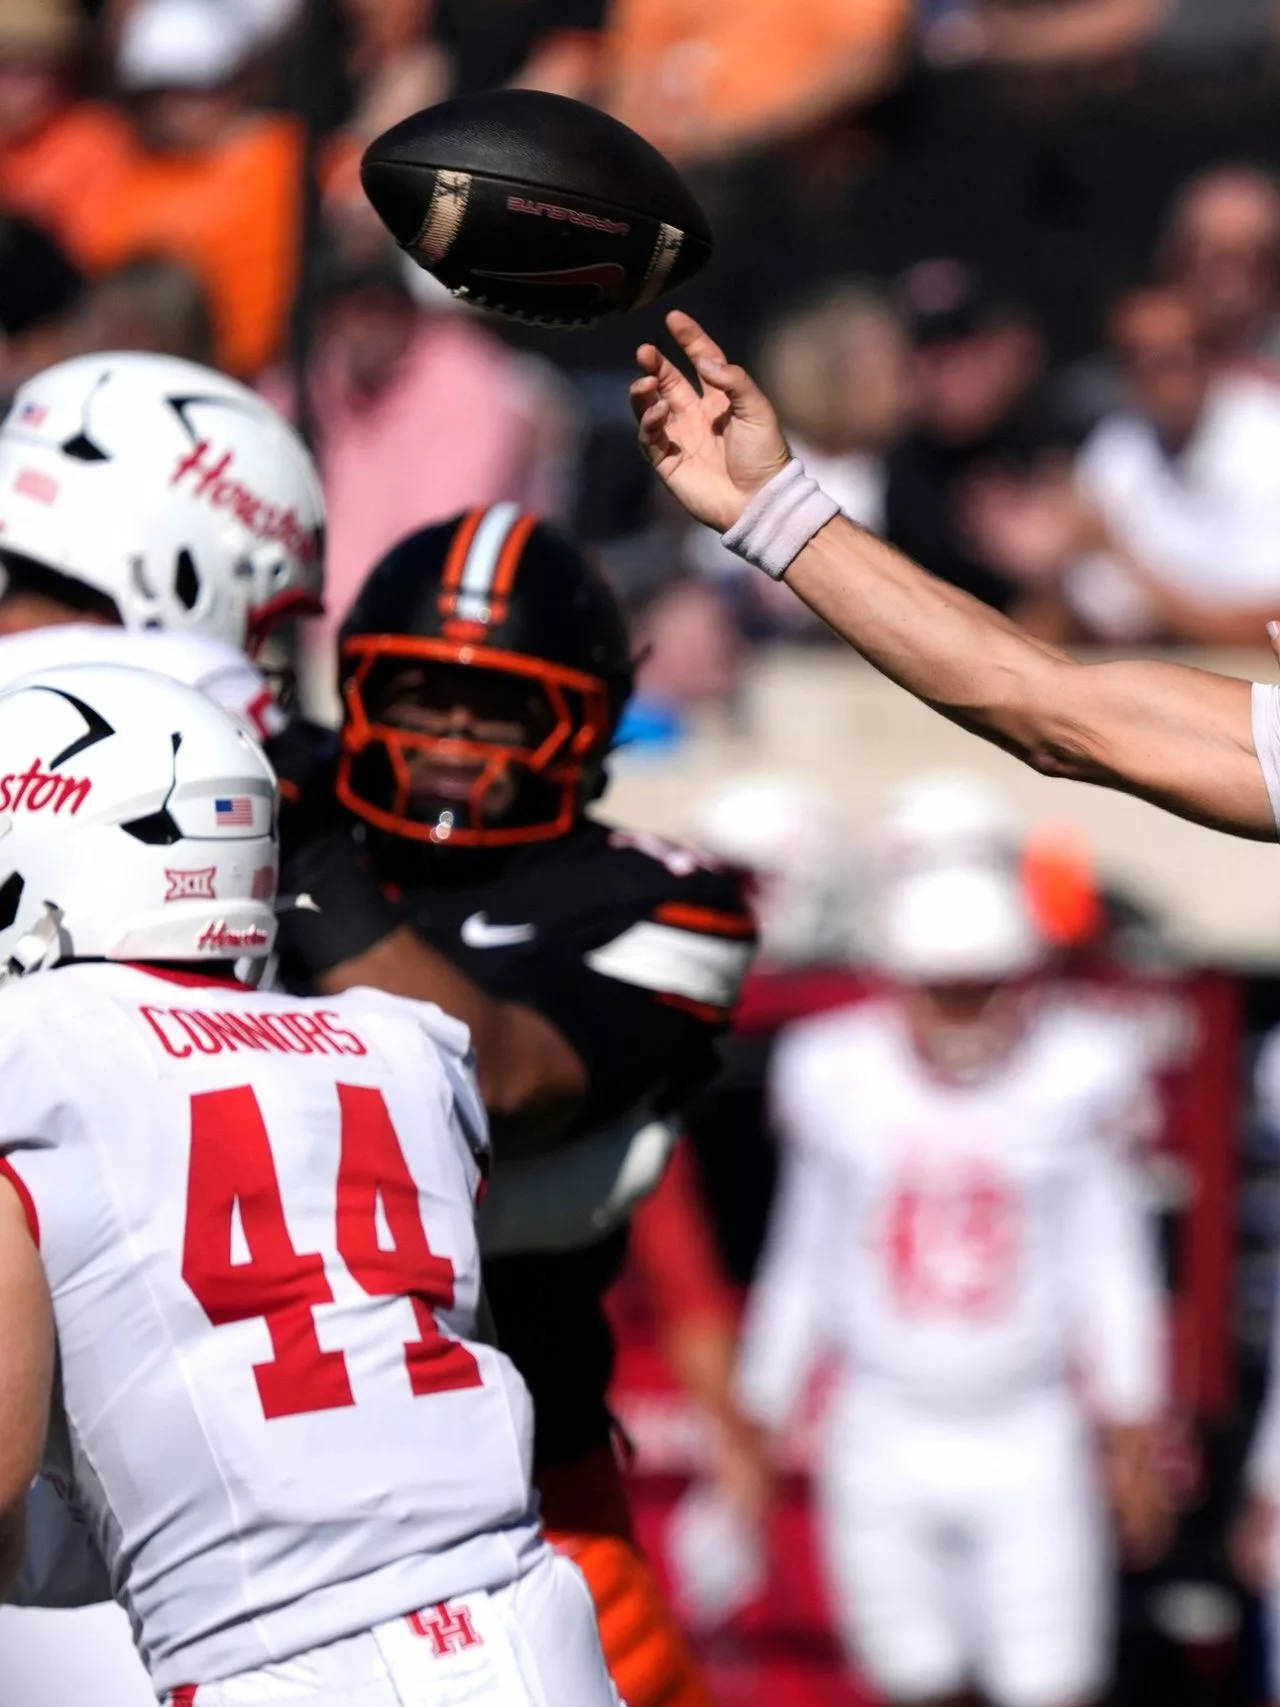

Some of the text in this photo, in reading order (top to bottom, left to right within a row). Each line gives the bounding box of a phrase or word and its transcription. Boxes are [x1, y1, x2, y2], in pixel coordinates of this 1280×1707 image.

[0, 757, 92, 816] ston
[138, 1004, 368, 1059] CONNORS
[181, 1079, 485, 1422] 44
